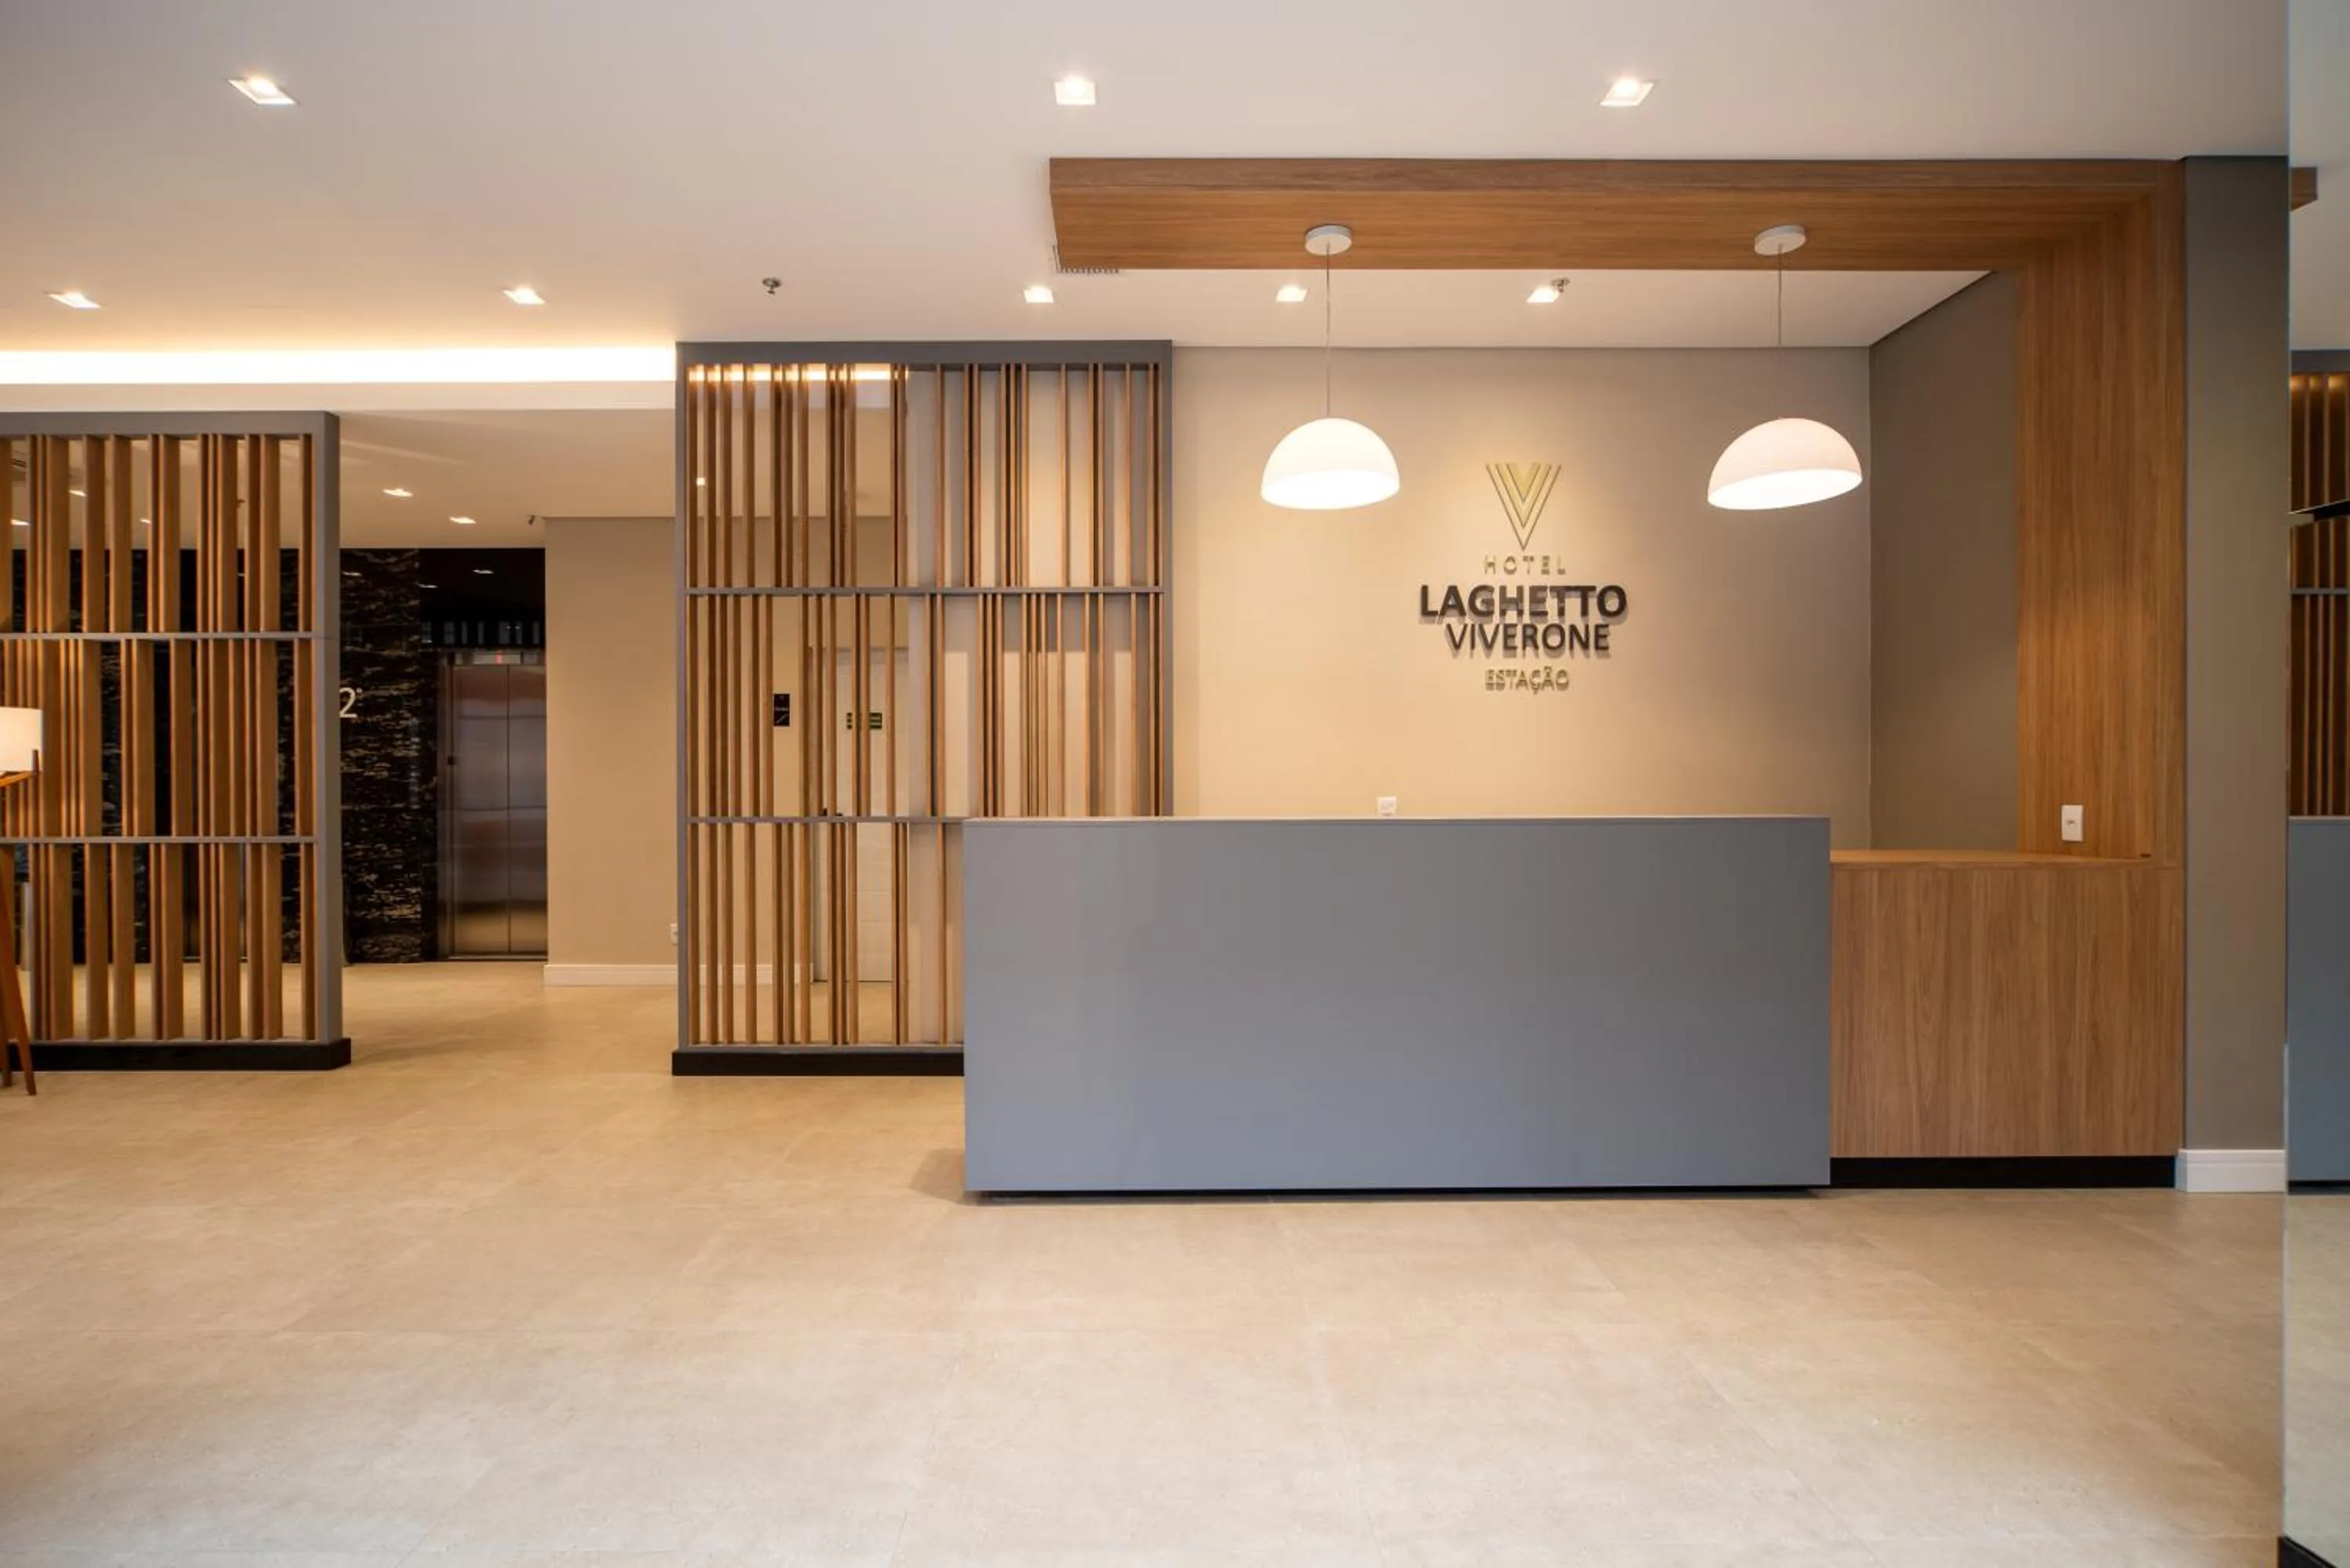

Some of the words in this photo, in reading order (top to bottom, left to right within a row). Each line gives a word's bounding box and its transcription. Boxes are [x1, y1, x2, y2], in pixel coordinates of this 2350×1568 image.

[1484, 555, 1566, 575] HOTEL
[1419, 584, 1628, 618] LAGHETTO
[1446, 623, 1610, 651] VIVERONE
[1485, 666, 1570, 695] ESTAÇÃO
